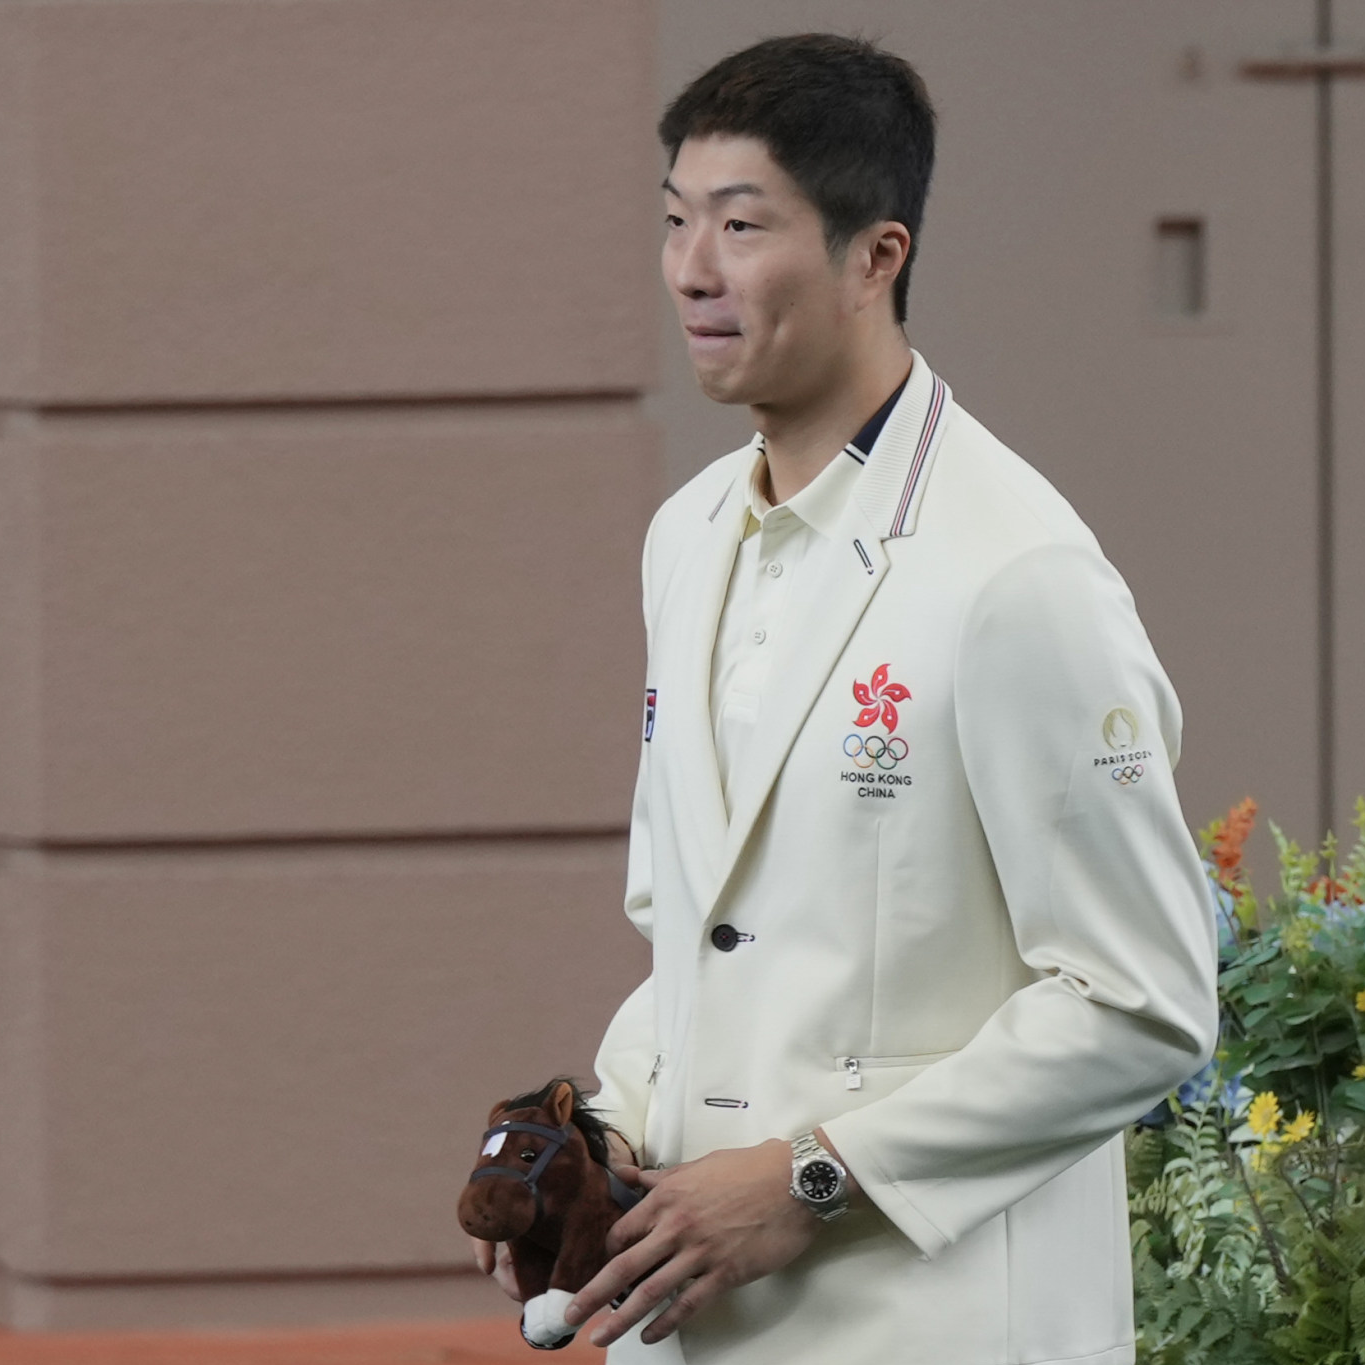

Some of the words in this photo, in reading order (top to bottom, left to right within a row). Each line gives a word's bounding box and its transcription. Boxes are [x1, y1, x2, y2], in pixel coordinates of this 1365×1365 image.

[840, 771, 875, 784] HONG
[878, 774, 912, 786] KONG
[857, 787, 896, 799] CHINA
